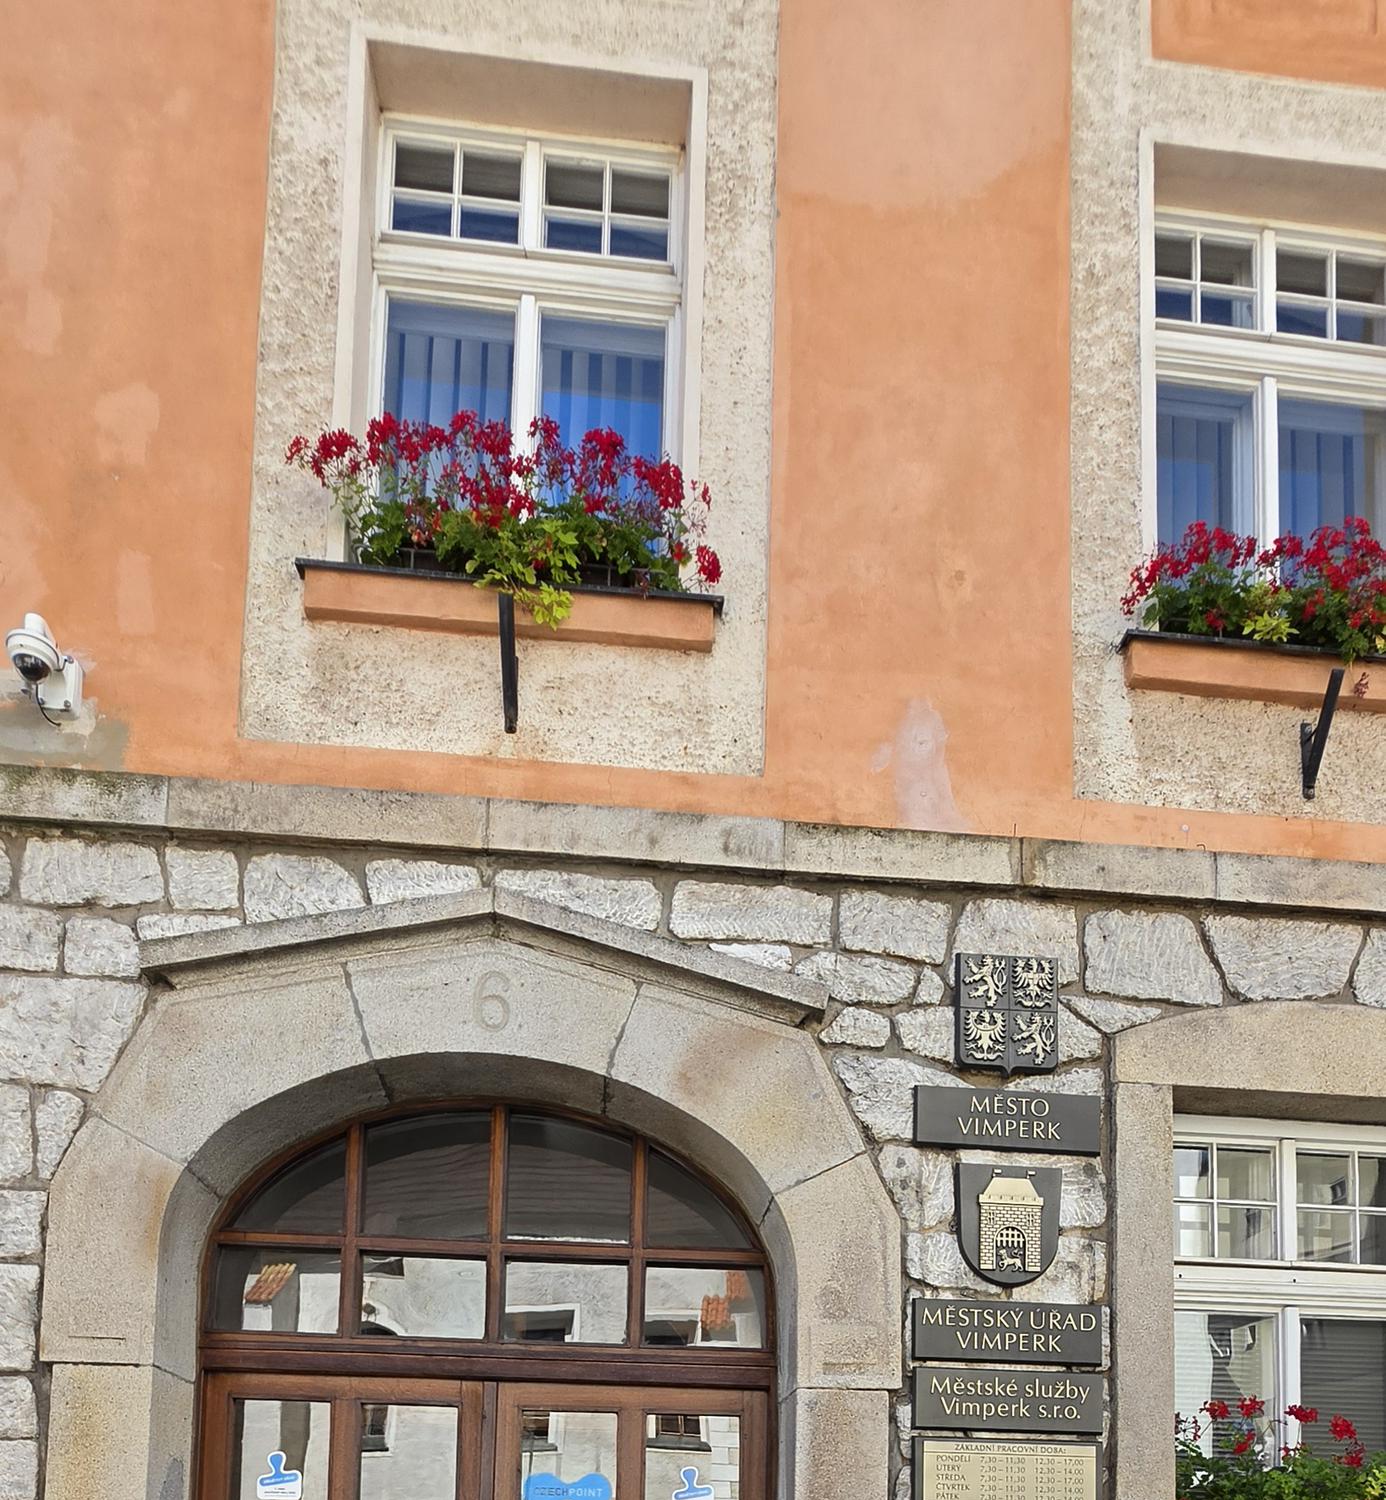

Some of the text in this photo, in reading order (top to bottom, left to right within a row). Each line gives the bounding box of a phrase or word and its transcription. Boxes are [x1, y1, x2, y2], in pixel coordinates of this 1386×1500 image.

[473, 970, 511, 1032] 6
[970, 1094, 1049, 1117] MĚSTO
[958, 1117, 1061, 1140] VIMPERK
[922, 1305, 1096, 1331] MĚSTSKÝ ÚŘAD
[956, 1331, 1062, 1352] VIMPERK
[931, 1376, 1090, 1403] Městské služby
[941, 1397, 1080, 1420] Vimperk s.r.o.
[954, 1444, 994, 1452] ZÁKLADNÍ
[997, 1445, 1038, 1453] PRACOVNÍ
[936, 1473, 966, 1481] STŘEDA
[936, 1492, 960, 1500] PÁTEK
